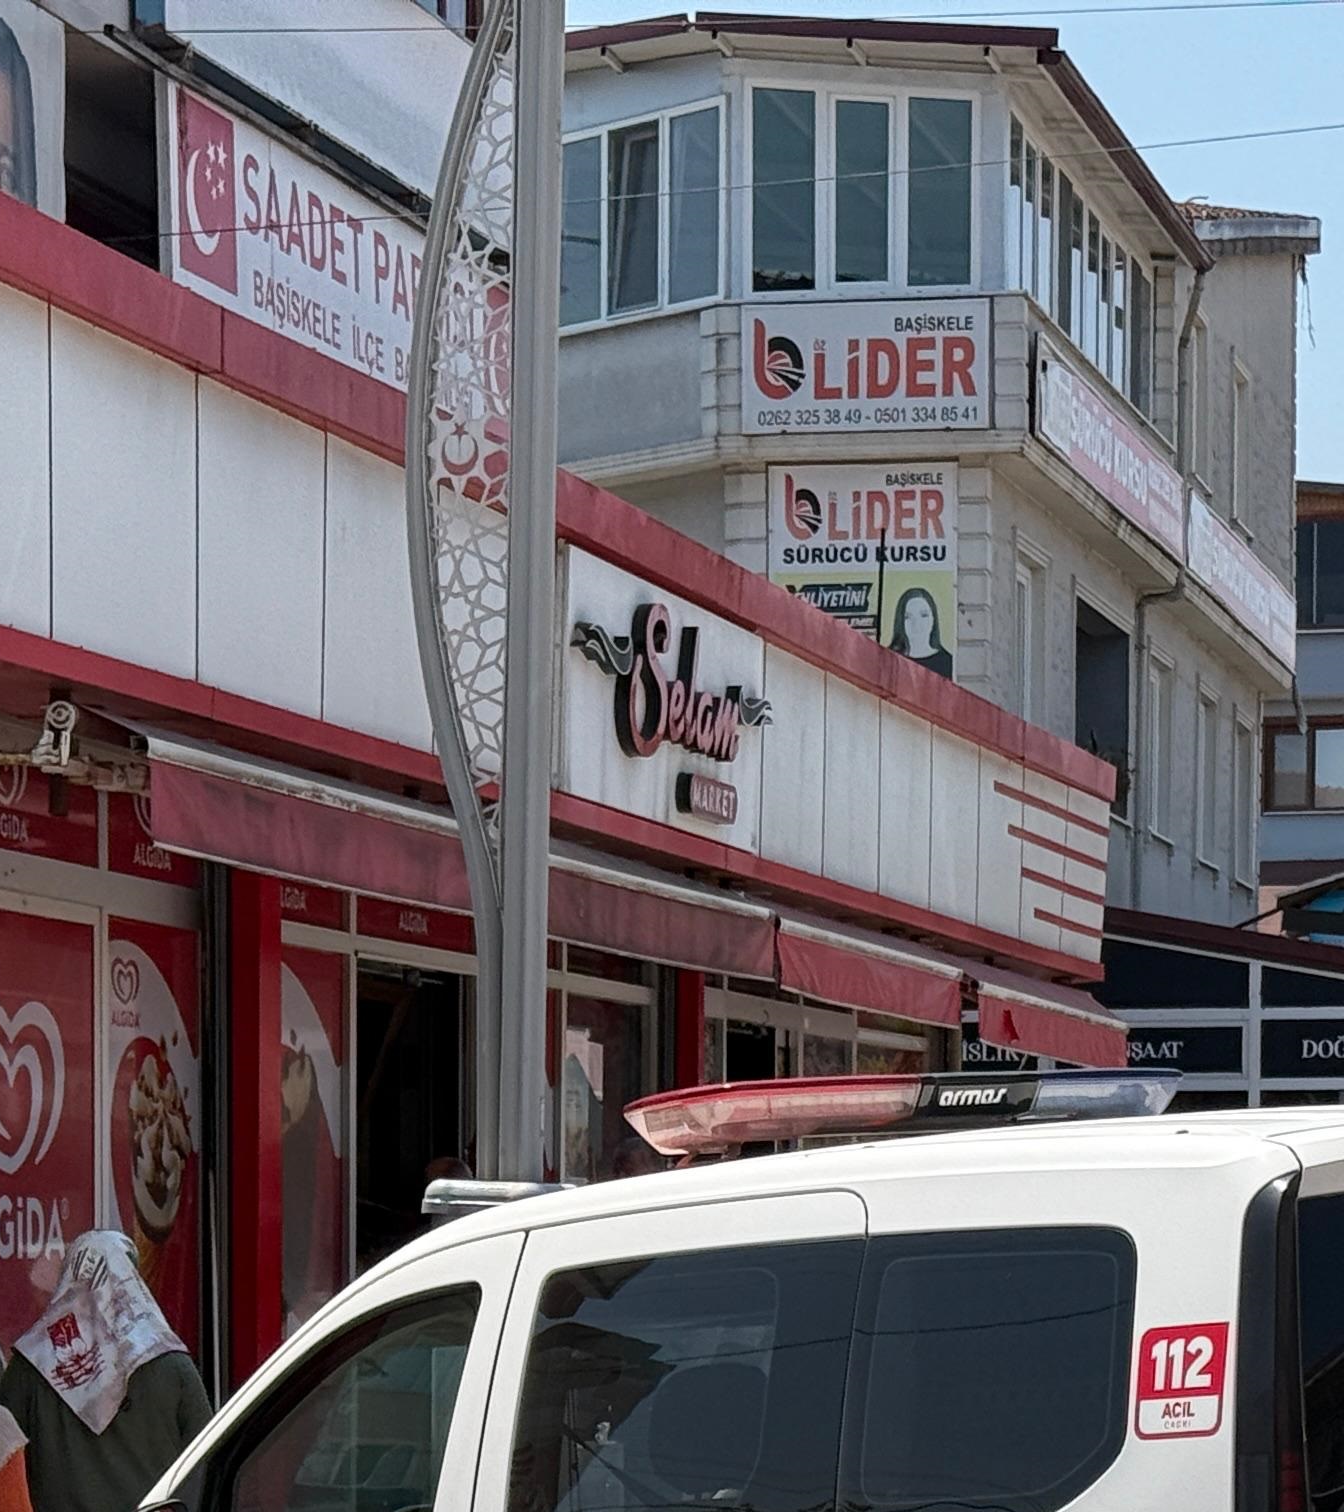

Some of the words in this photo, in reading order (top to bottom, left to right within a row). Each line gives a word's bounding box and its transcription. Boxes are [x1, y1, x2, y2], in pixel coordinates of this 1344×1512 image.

[243, 154, 364, 294] SAADET
[253, 269, 342, 350] BAŞİSKELE
[352, 315, 385, 376] İLÇE
[894, 313, 974, 334] BAŞİSKELE
[758, 410, 791, 426] 0262
[795, 409, 820, 425] 325
[824, 409, 841, 424] 38
[874, 407, 907, 424] 0501
[912, 407, 937, 423] 334
[941, 406, 958, 422] 85
[961, 406, 978, 422] 41
[885, 472, 944, 488] BAŞİSKELE
[783, 543, 868, 564] SÜRÜCÜ
[875, 545, 947, 563] KURSU
[693, 781, 736, 820] MARKET
[1150, 1335, 1214, 1392] 112
